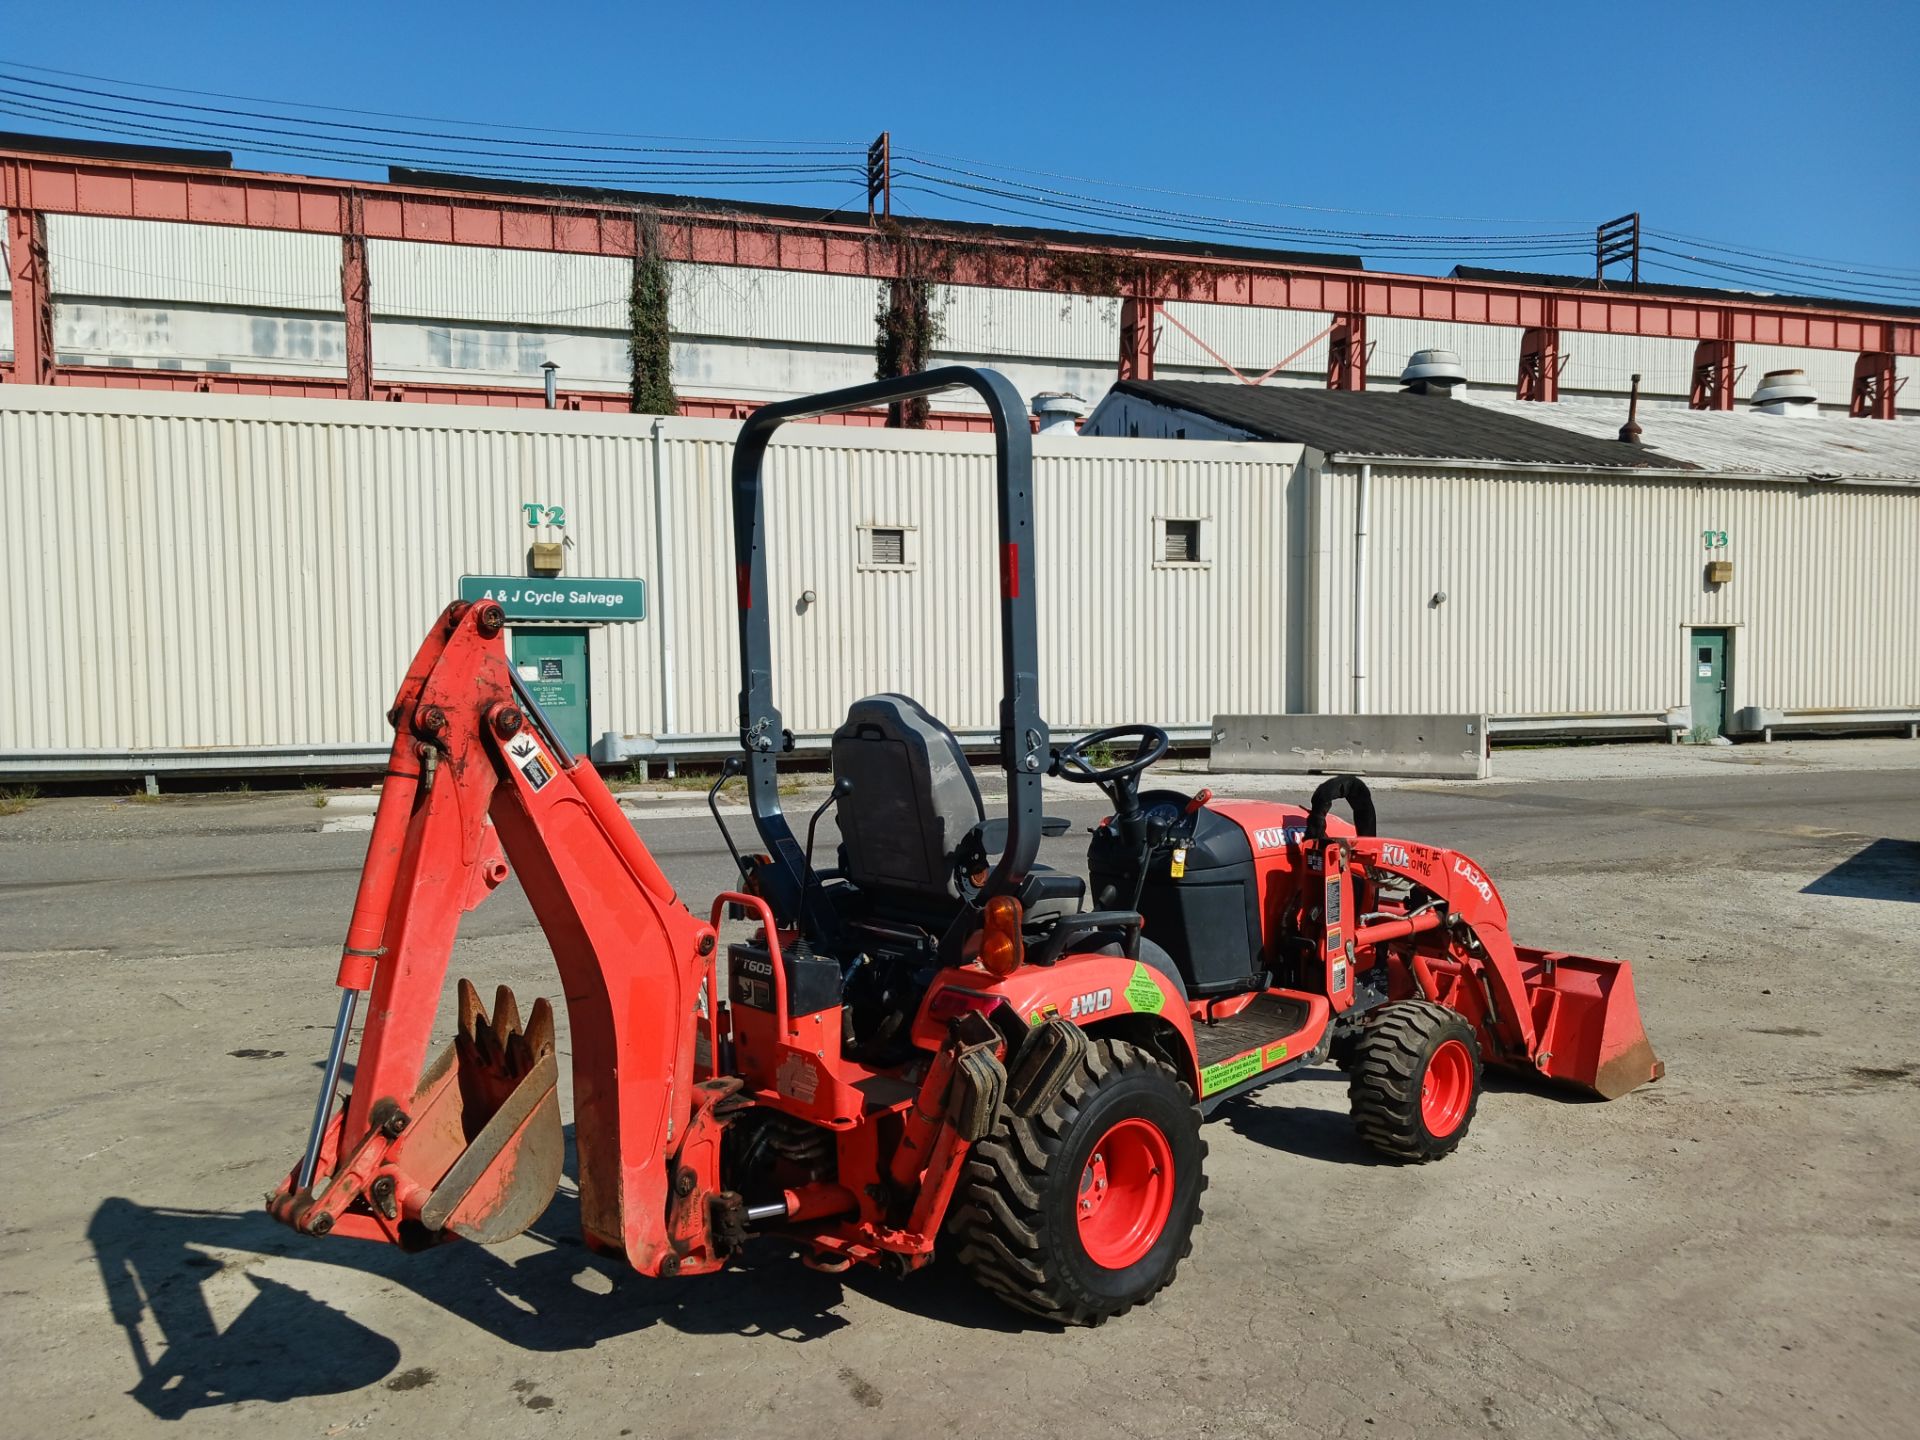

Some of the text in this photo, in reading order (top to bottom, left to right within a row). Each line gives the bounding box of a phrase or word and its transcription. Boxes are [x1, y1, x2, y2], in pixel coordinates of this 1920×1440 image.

[1703, 530, 1728, 548] T3
[483, 589, 624, 607] A & J Cycle Salvage
[1453, 857, 1493, 903] LA340
